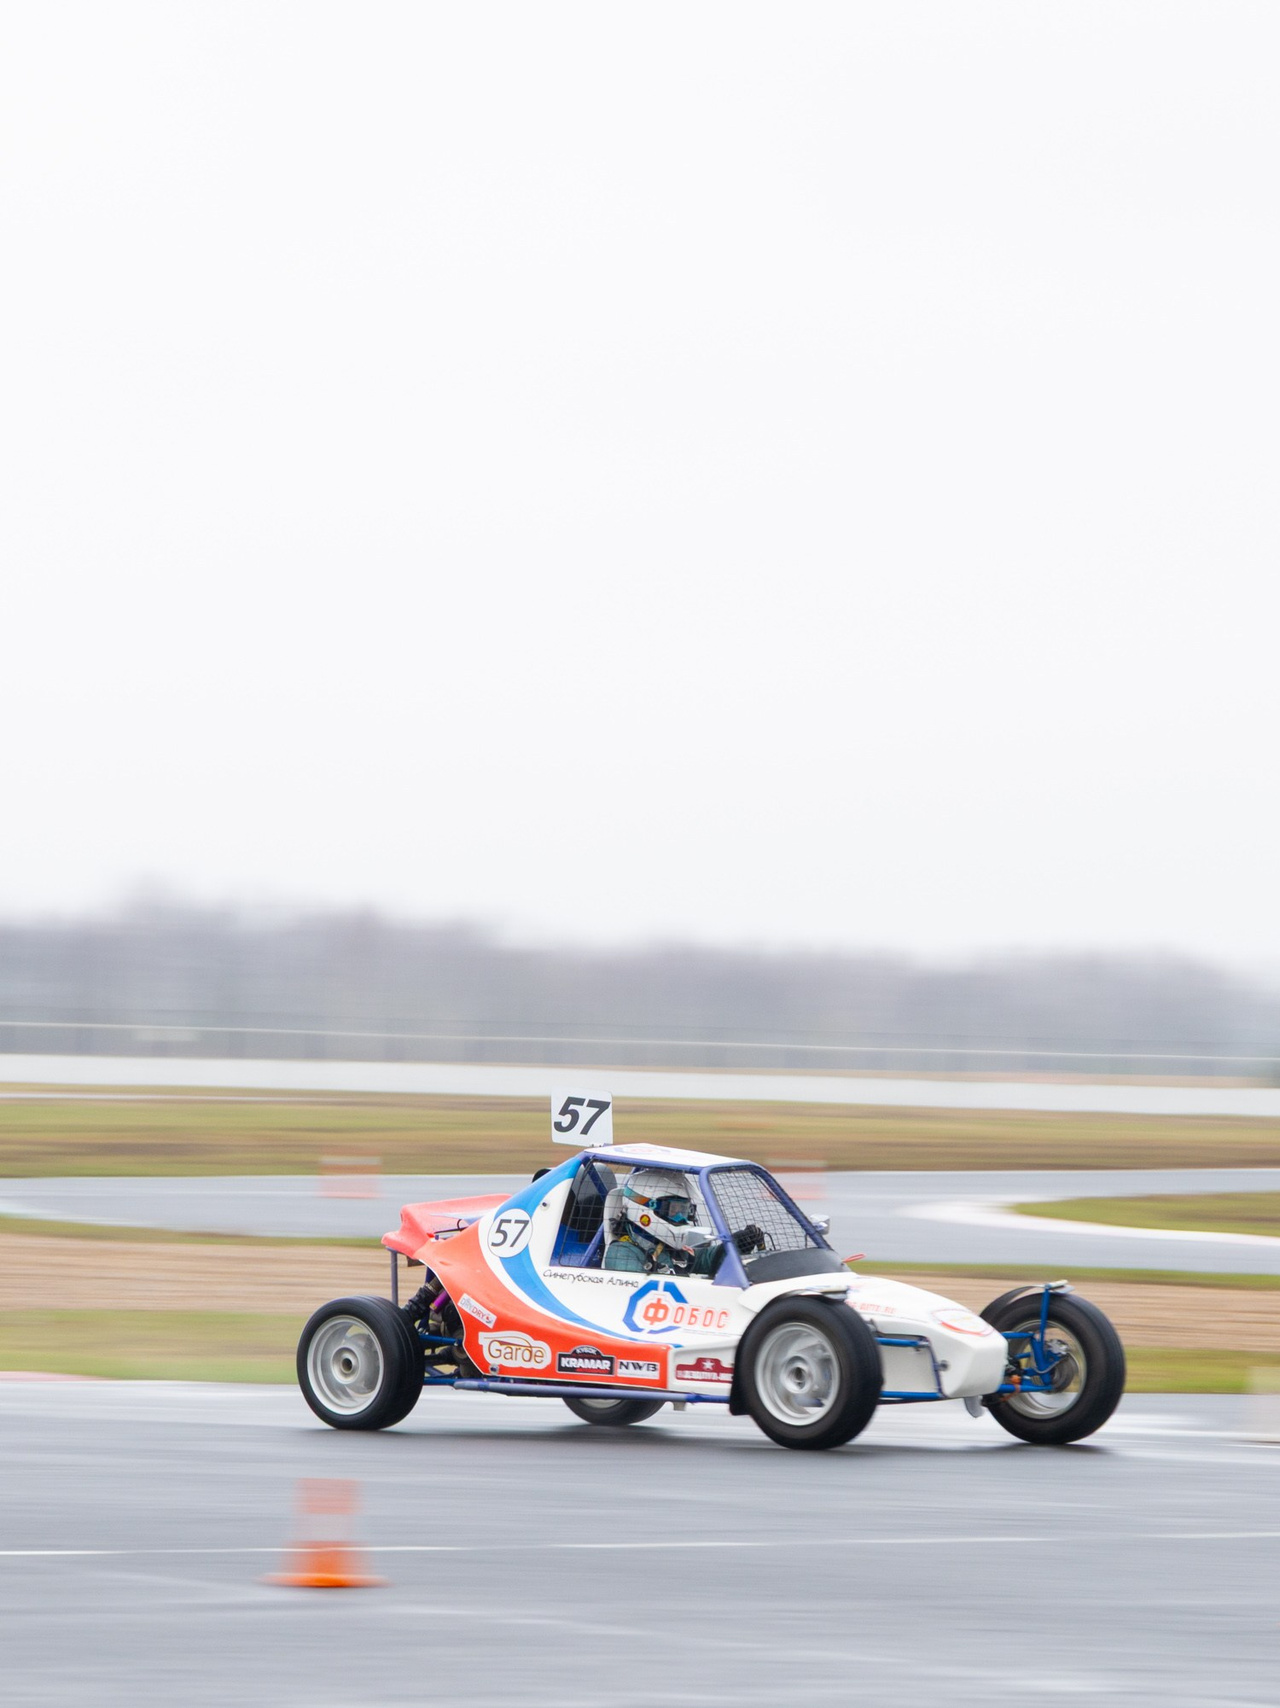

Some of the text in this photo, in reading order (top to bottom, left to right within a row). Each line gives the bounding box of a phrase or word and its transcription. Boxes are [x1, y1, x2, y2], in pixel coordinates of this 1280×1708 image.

[553, 1096, 611, 1136] 57
[491, 1218, 530, 1248] 57
[606, 1276, 640, 1289] Алина
[642, 1297, 729, 1329] ФОБОС
[487, 1339, 546, 1365] Garde
[560, 1357, 611, 1371] KRAMAR
[618, 1360, 658, 1373] NWB
